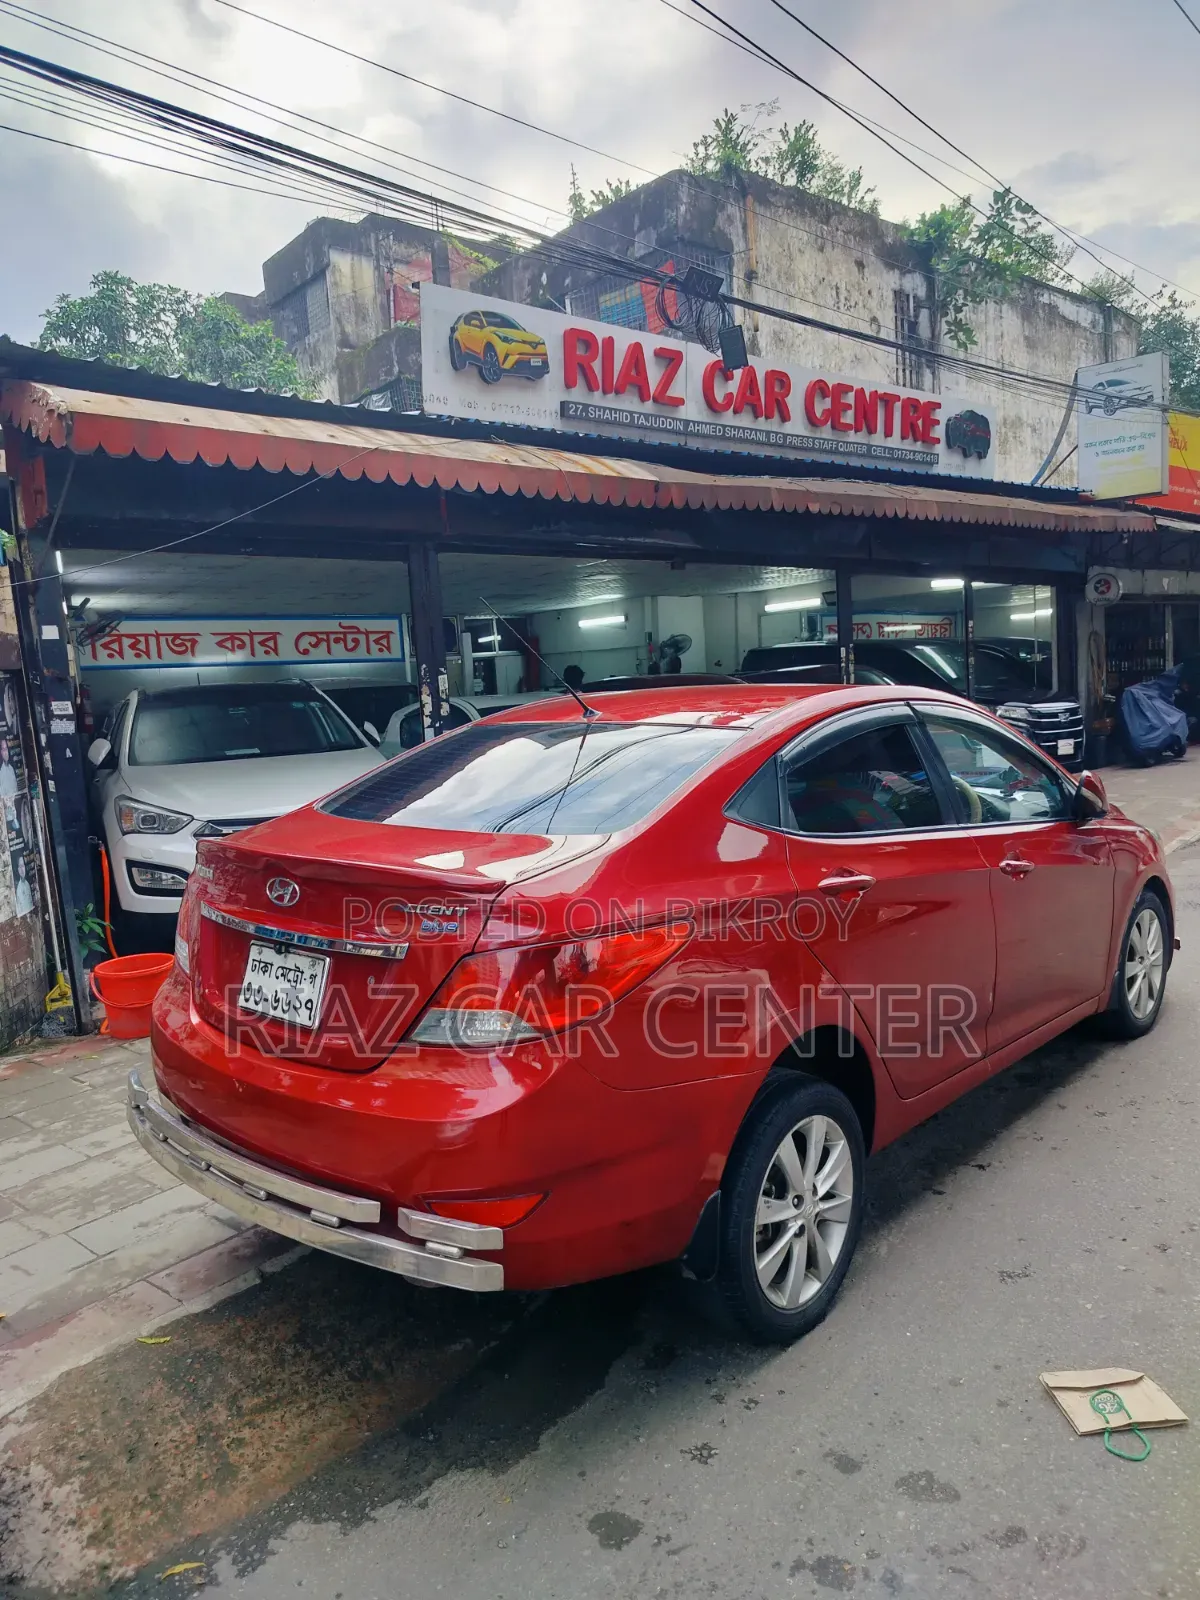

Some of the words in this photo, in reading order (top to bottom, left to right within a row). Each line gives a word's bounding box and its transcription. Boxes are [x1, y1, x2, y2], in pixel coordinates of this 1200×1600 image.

[563, 327, 685, 407] RIAZ
[702, 359, 791, 423] CAR
[805, 379, 942, 444] CENTRE
[569, 403, 586, 417] 27,
[588, 407, 630, 423] SHAHID
[633, 413, 684, 431] TAJUDDIN
[688, 424, 723, 437] AHMED
[725, 428, 767, 443] SHARANI,
[770, 433, 784, 444] BG
[787, 436, 813, 448] PRESS
[814, 439, 837, 451] STAFF
[838, 443, 867, 454] QUATER
[872, 446, 892, 458] CELL:
[90, 625, 202, 661] রিয়াজ
[210, 629, 283, 658] কার
[294, 621, 396, 656] সেন্টার
[421, 918, 458, 933] blue
[251, 958, 274, 978] ঢাকা
[243, 981, 314, 1021] ৩৩-৬৬২৭
